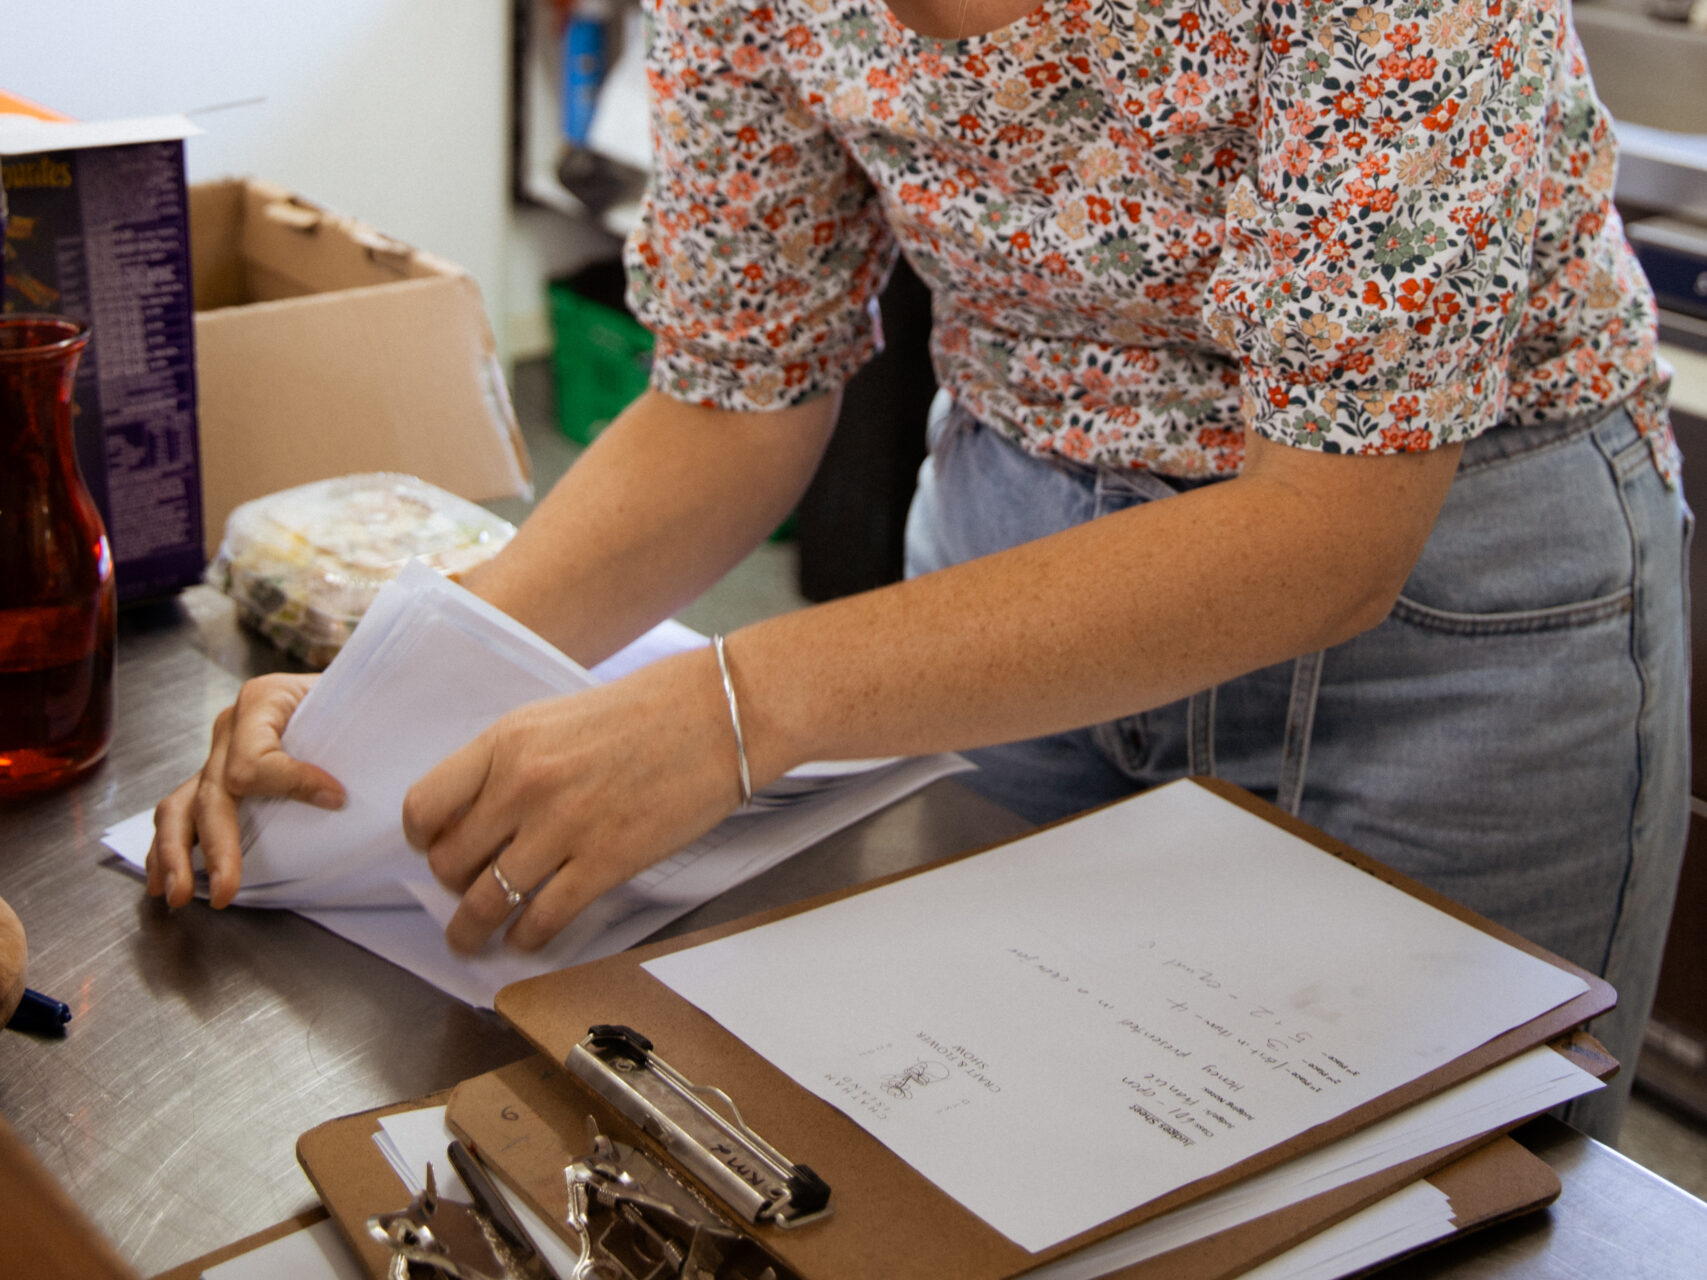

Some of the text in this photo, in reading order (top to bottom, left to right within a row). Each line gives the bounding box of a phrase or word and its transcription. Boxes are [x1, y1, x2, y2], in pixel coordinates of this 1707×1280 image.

[916, 1032, 962, 1060] FLOWER
[1118, 1019, 1192, 1058] presented
[954, 1046, 988, 1069] SHOW
[966, 1069, 1001, 1093] CRAFT
[1201, 1065, 1244, 1092] Honey
[1129, 1104, 1195, 1146] Judges Sheet
